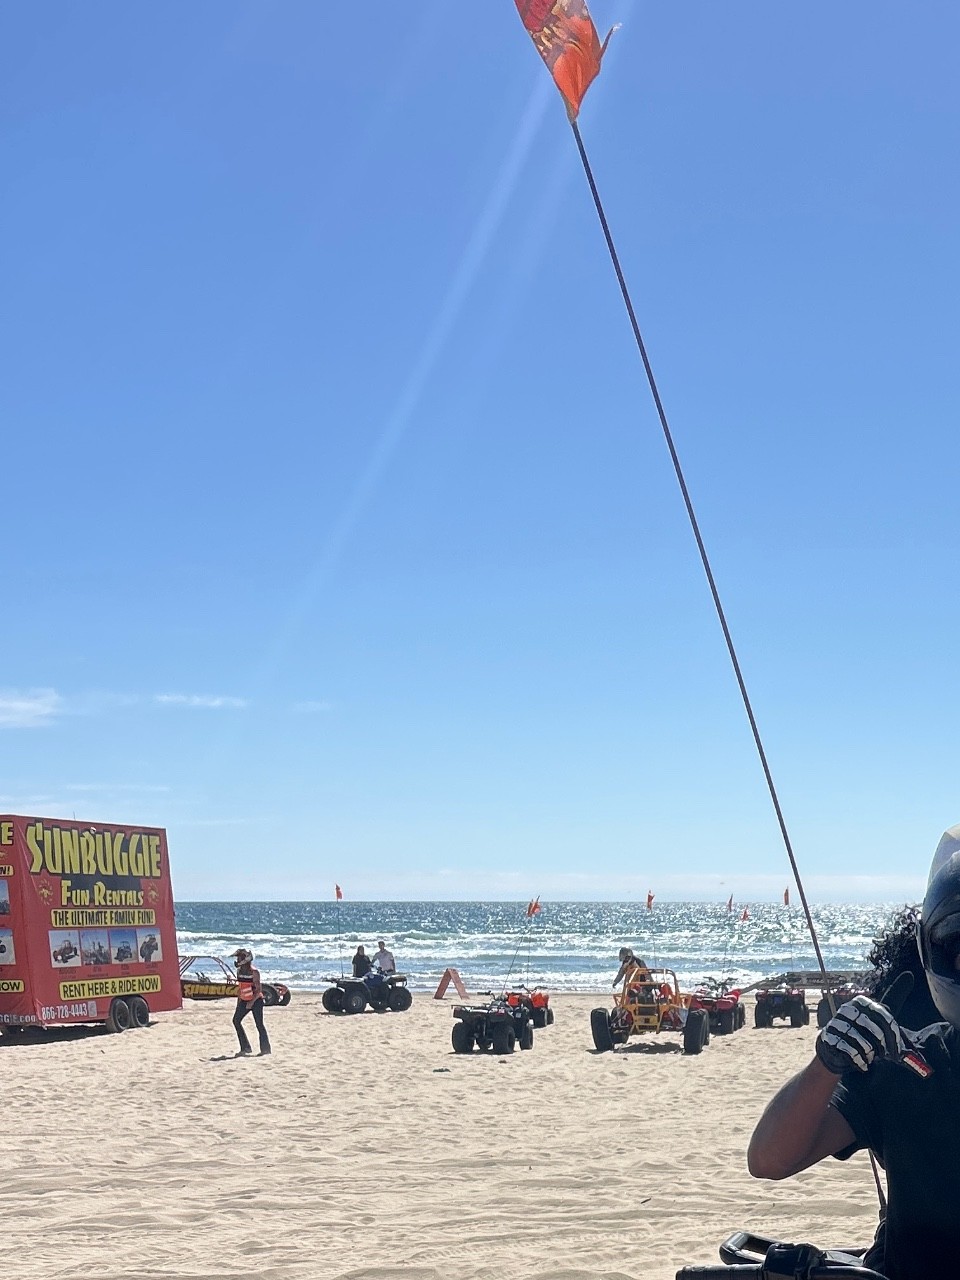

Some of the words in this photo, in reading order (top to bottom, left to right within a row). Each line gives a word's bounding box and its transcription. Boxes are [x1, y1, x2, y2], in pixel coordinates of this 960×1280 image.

[26, 822, 161, 877] SUNBUGGIE
[61, 879, 90, 906] FUN
[93, 881, 144, 906] RENTALS
[53, 910, 69, 926] THE
[71, 910, 108, 925] ULTIMATE
[109, 910, 136, 925] FAMILY
[137, 910, 154, 924] FUN!
[0, 981, 21, 991] OW
[62, 983, 86, 998] RENT
[87, 981, 110, 996] HERE
[110, 980, 118, 994] &
[118, 979, 137, 993] RIDE
[137, 977, 159, 991] NOW
[41, 1003, 88, 1020] 866-728-4443
